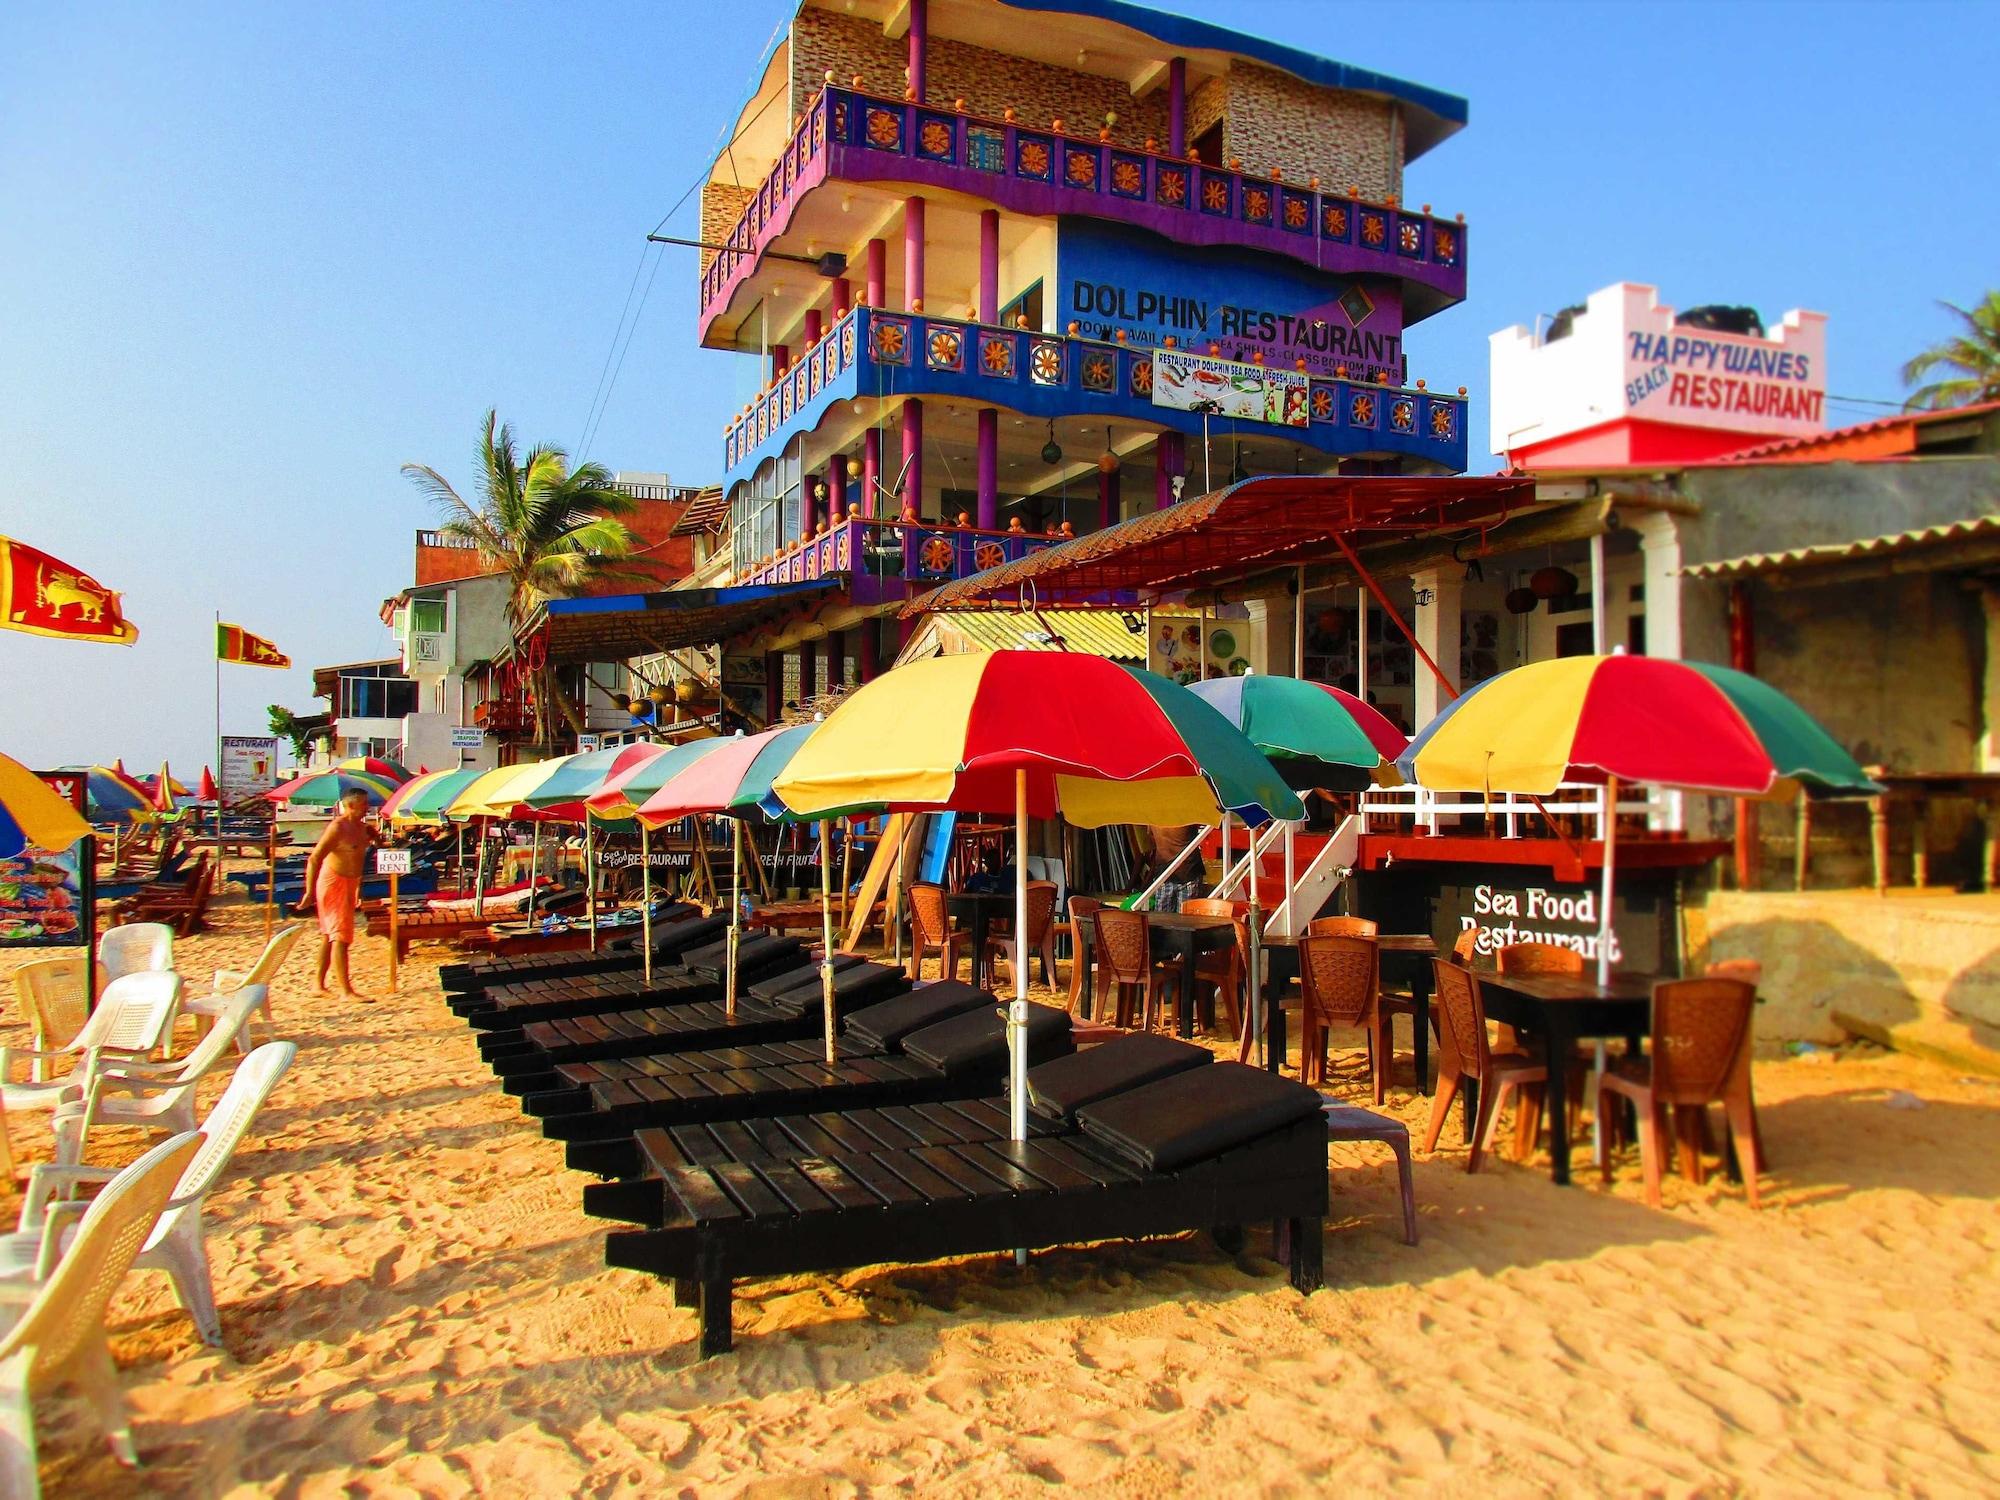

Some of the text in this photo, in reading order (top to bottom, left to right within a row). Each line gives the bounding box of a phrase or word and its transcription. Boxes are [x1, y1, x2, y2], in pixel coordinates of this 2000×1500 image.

[1073, 280, 1400, 365] DOLPHIN RESTAURANT
[1159, 353, 1201, 370] RESTAURANT
[1202, 361, 1230, 375] DOLPHIN
[1231, 365, 1243, 375] SEA
[1245, 367, 1261, 379] FOOD
[1629, 331, 1809, 381] HAPPY WAVES
[1625, 363, 1670, 407] BEACH
[1668, 372, 1824, 422] RESTAURANT
[224, 739, 275, 748] RESTURANT
[379, 863, 409, 872] RENT
[383, 853, 406, 861] FOR
[603, 850, 620, 862] Sea
[627, 854, 691, 866] RESTAURANT
[1473, 884, 1597, 923] Sea Food
